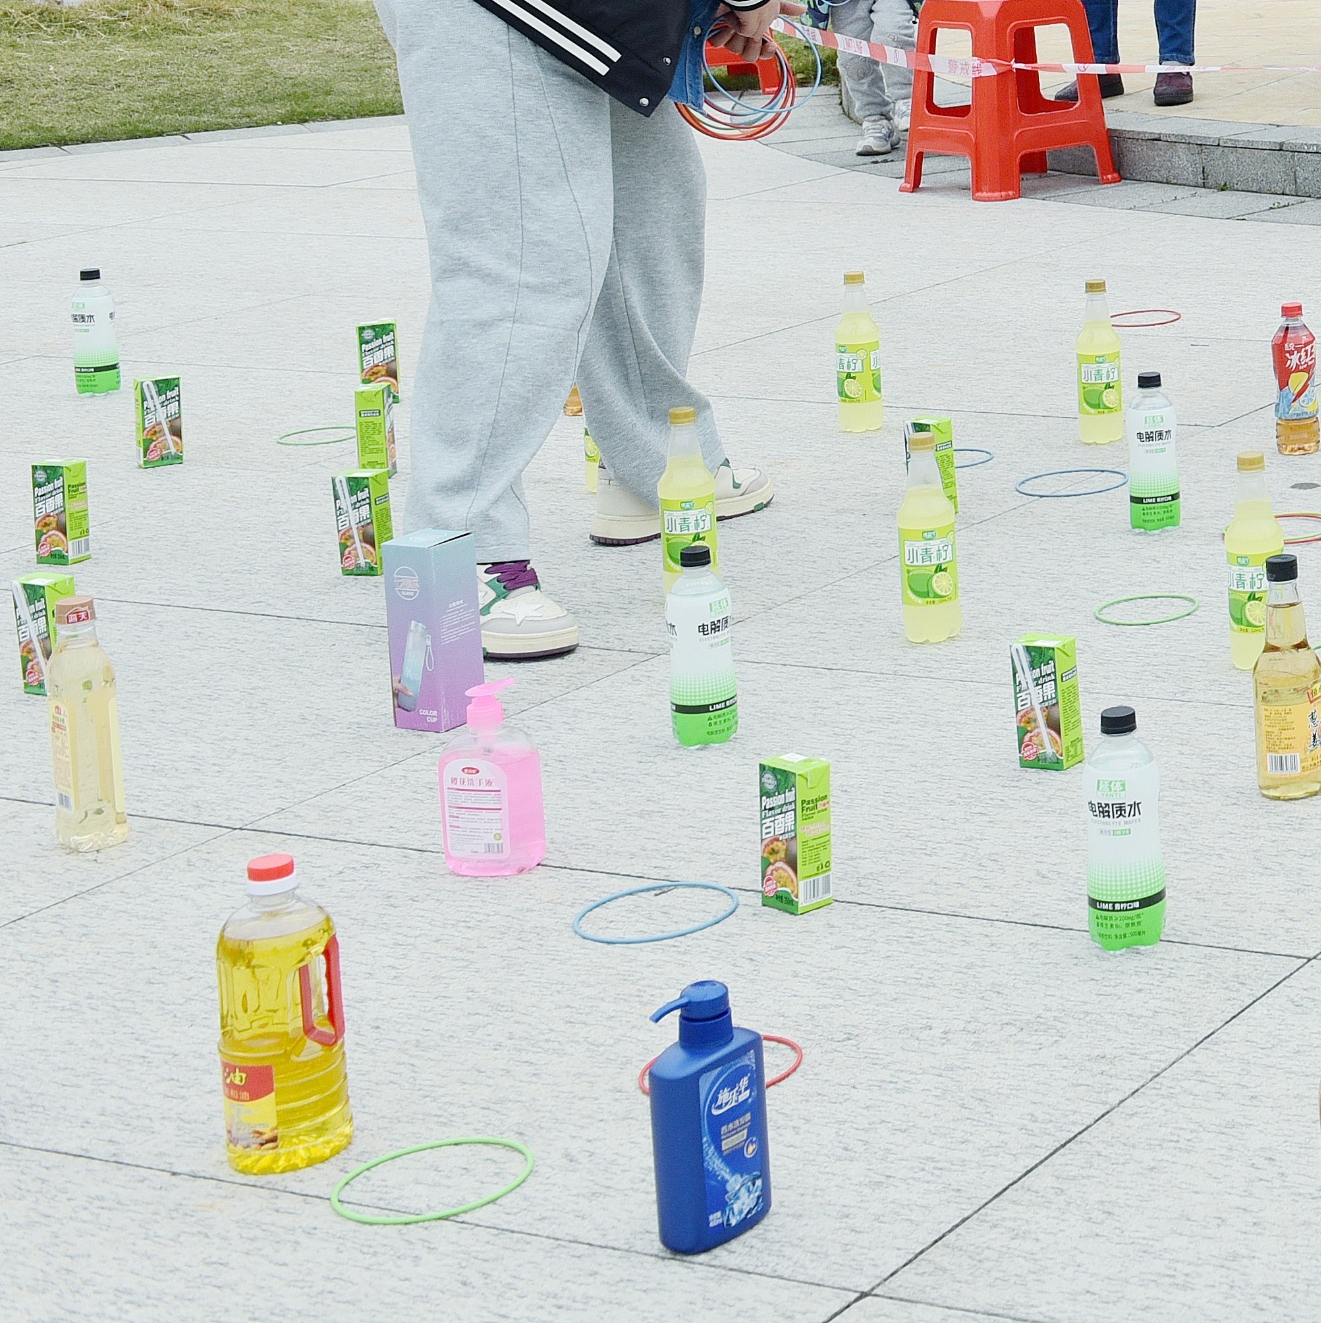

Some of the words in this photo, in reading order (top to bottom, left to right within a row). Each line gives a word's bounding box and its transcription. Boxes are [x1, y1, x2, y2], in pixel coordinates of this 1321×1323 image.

[1285, 348, 1316, 371] 冰红
[1083, 367, 1116, 382] 小青柠
[1136, 429, 1172, 442] 电解质水
[667, 514, 707, 534] 小青柠
[907, 543, 949, 565] 小青柠
[419, 709, 438, 718] COLOR
[426, 716, 438, 724] CUP
[761, 790, 785, 811] Passion
[801, 794, 828, 809] Passion
[1088, 800, 1142, 820] 电解质水
[762, 809, 796, 840] 百香果
[1096, 901, 1113, 911] LIME
